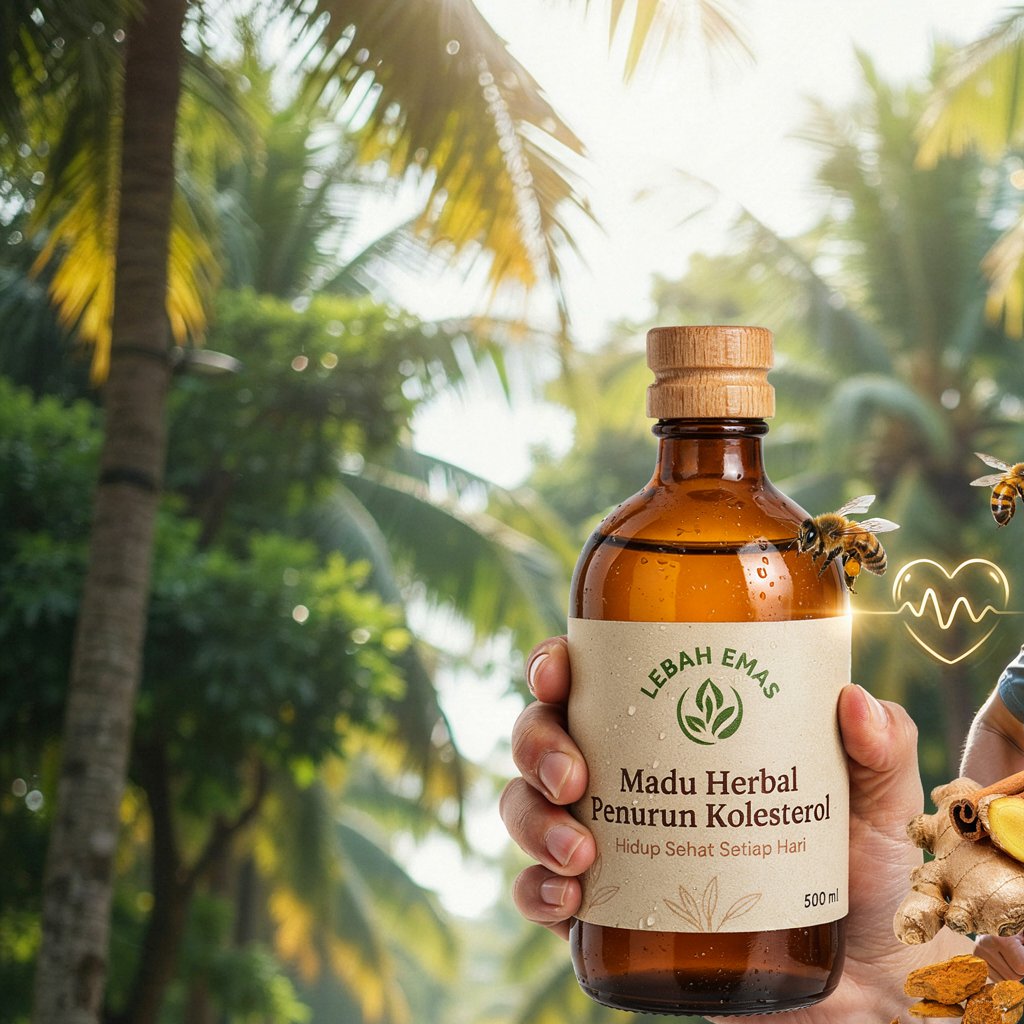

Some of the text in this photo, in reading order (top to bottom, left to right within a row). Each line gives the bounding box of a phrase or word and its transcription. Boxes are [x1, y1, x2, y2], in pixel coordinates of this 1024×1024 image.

[640, 646, 780, 699] LEBAH EMAS
[620, 766, 799, 795] Madu Herbal
[591, 794, 831, 828] Penurun Kolesterol
[615, 837, 807, 859] Hidup Sehat Setiap Hari
[804, 888, 839, 908] 500 ml
